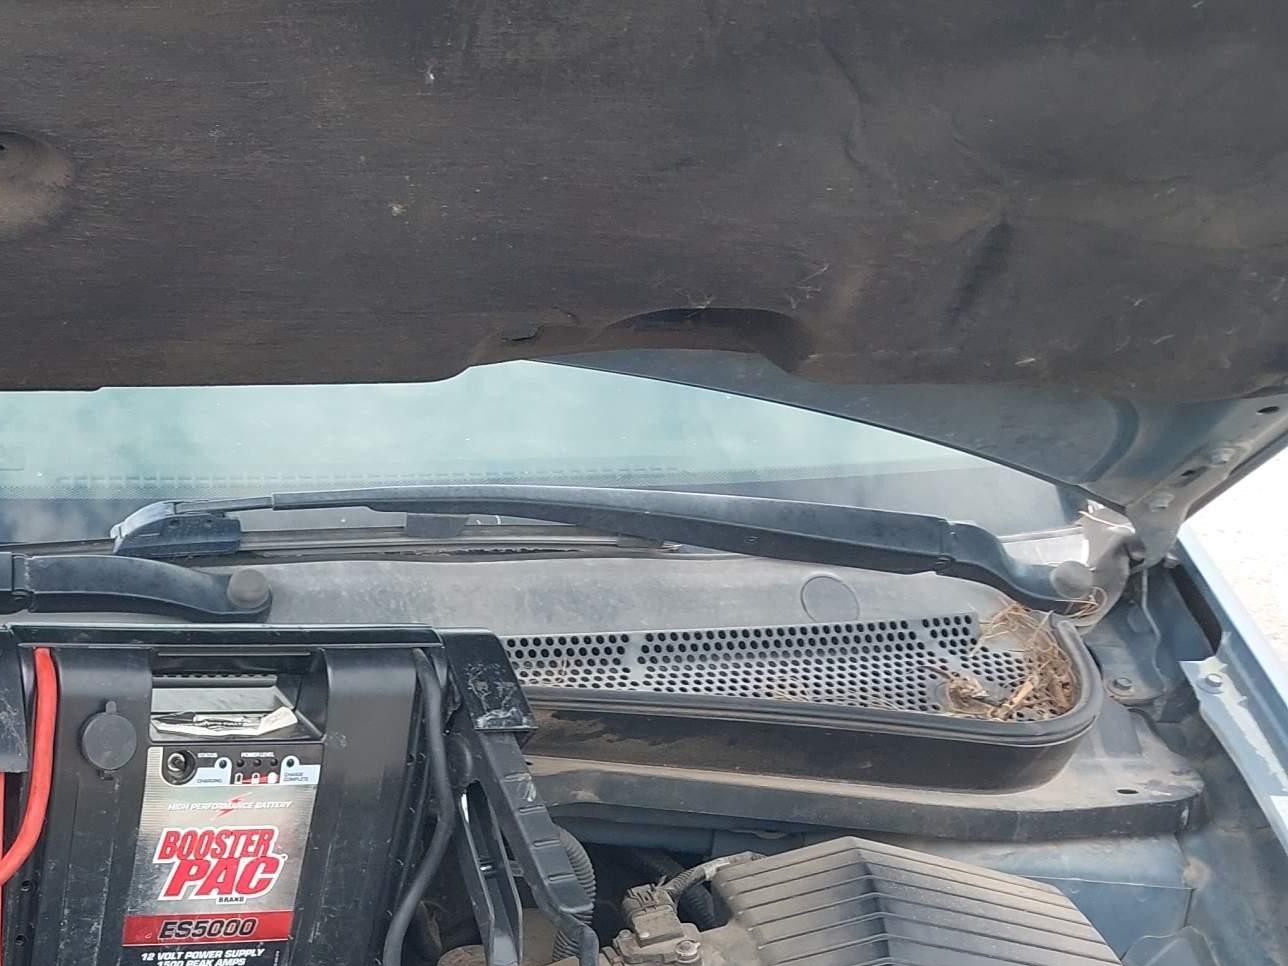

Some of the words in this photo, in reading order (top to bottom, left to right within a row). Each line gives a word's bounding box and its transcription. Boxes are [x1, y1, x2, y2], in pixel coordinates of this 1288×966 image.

[167, 802, 188, 810] HIGH
[190, 801, 253, 810] PERFORMANCE
[254, 800, 293, 809] BATTERY
[158, 828, 275, 861] BOOSTER
[162, 856, 280, 896] PAC
[159, 918, 257, 939] ES5000
[141, 952, 155, 961] 12
[157, 951, 183, 960] VOLT
[184, 950, 223, 960] POWER
[224, 948, 265, 958] SUPPLY
[214, 958, 246, 966] AMPS
